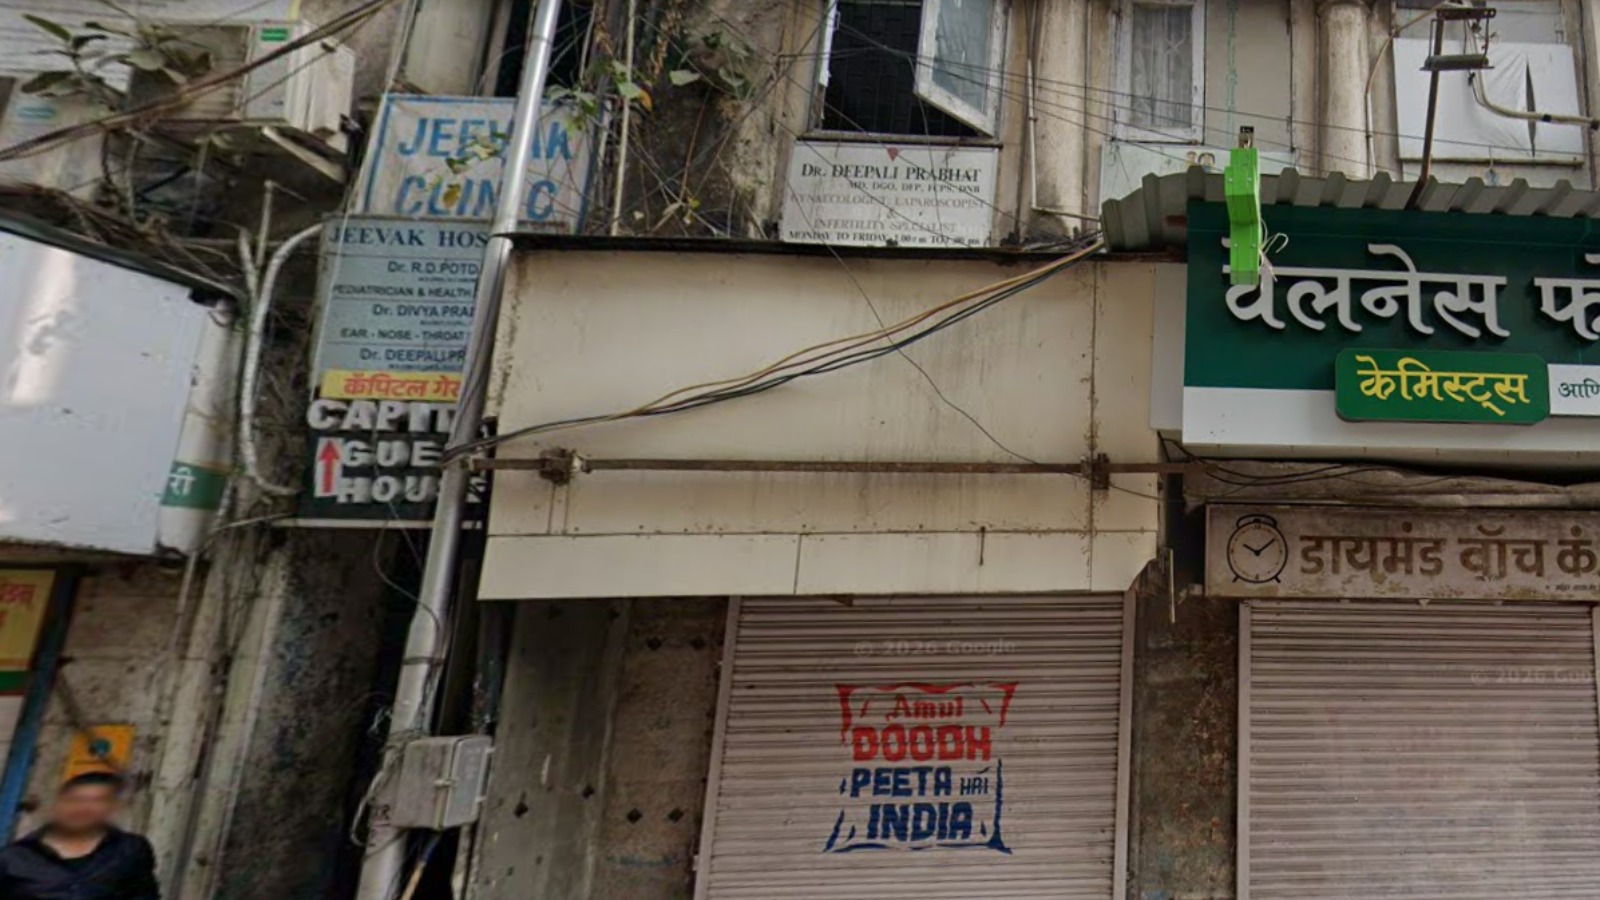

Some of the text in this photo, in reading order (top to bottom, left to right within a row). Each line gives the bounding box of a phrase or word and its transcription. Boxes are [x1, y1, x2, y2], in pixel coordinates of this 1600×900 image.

[398, 117, 572, 160] JEEVK
[801, 163, 982, 182] DR. DEEPALI PRABHAT
[395, 175, 557, 221] CLINC
[329, 226, 489, 248] JEEVAK HOS
[836, 231, 849, 241] TO
[388, 261, 405, 273] Dr.
[441, 262, 479, 275] POTD
[428, 288, 470, 298] HEALTH
[1222, 237, 1510, 339] वलनेस
[373, 304, 393, 315] Dr.
[397, 305, 439, 317] DIVYA
[340, 328, 368, 339] EAR
[378, 330, 411, 340] NOSE
[360, 348, 380, 359] Dr.
[307, 400, 457, 432] CAPIT
[342, 440, 442, 467] GUE
[336, 475, 487, 503] HOU
[1300, 521, 1446, 577] डायमंड
[1457, 524, 1548, 579] वॉच
[886, 693, 963, 721] Amul
[852, 723, 992, 762] DOODH
[850, 766, 989, 798] PEETA HAI
[867, 802, 973, 841] INDIA
